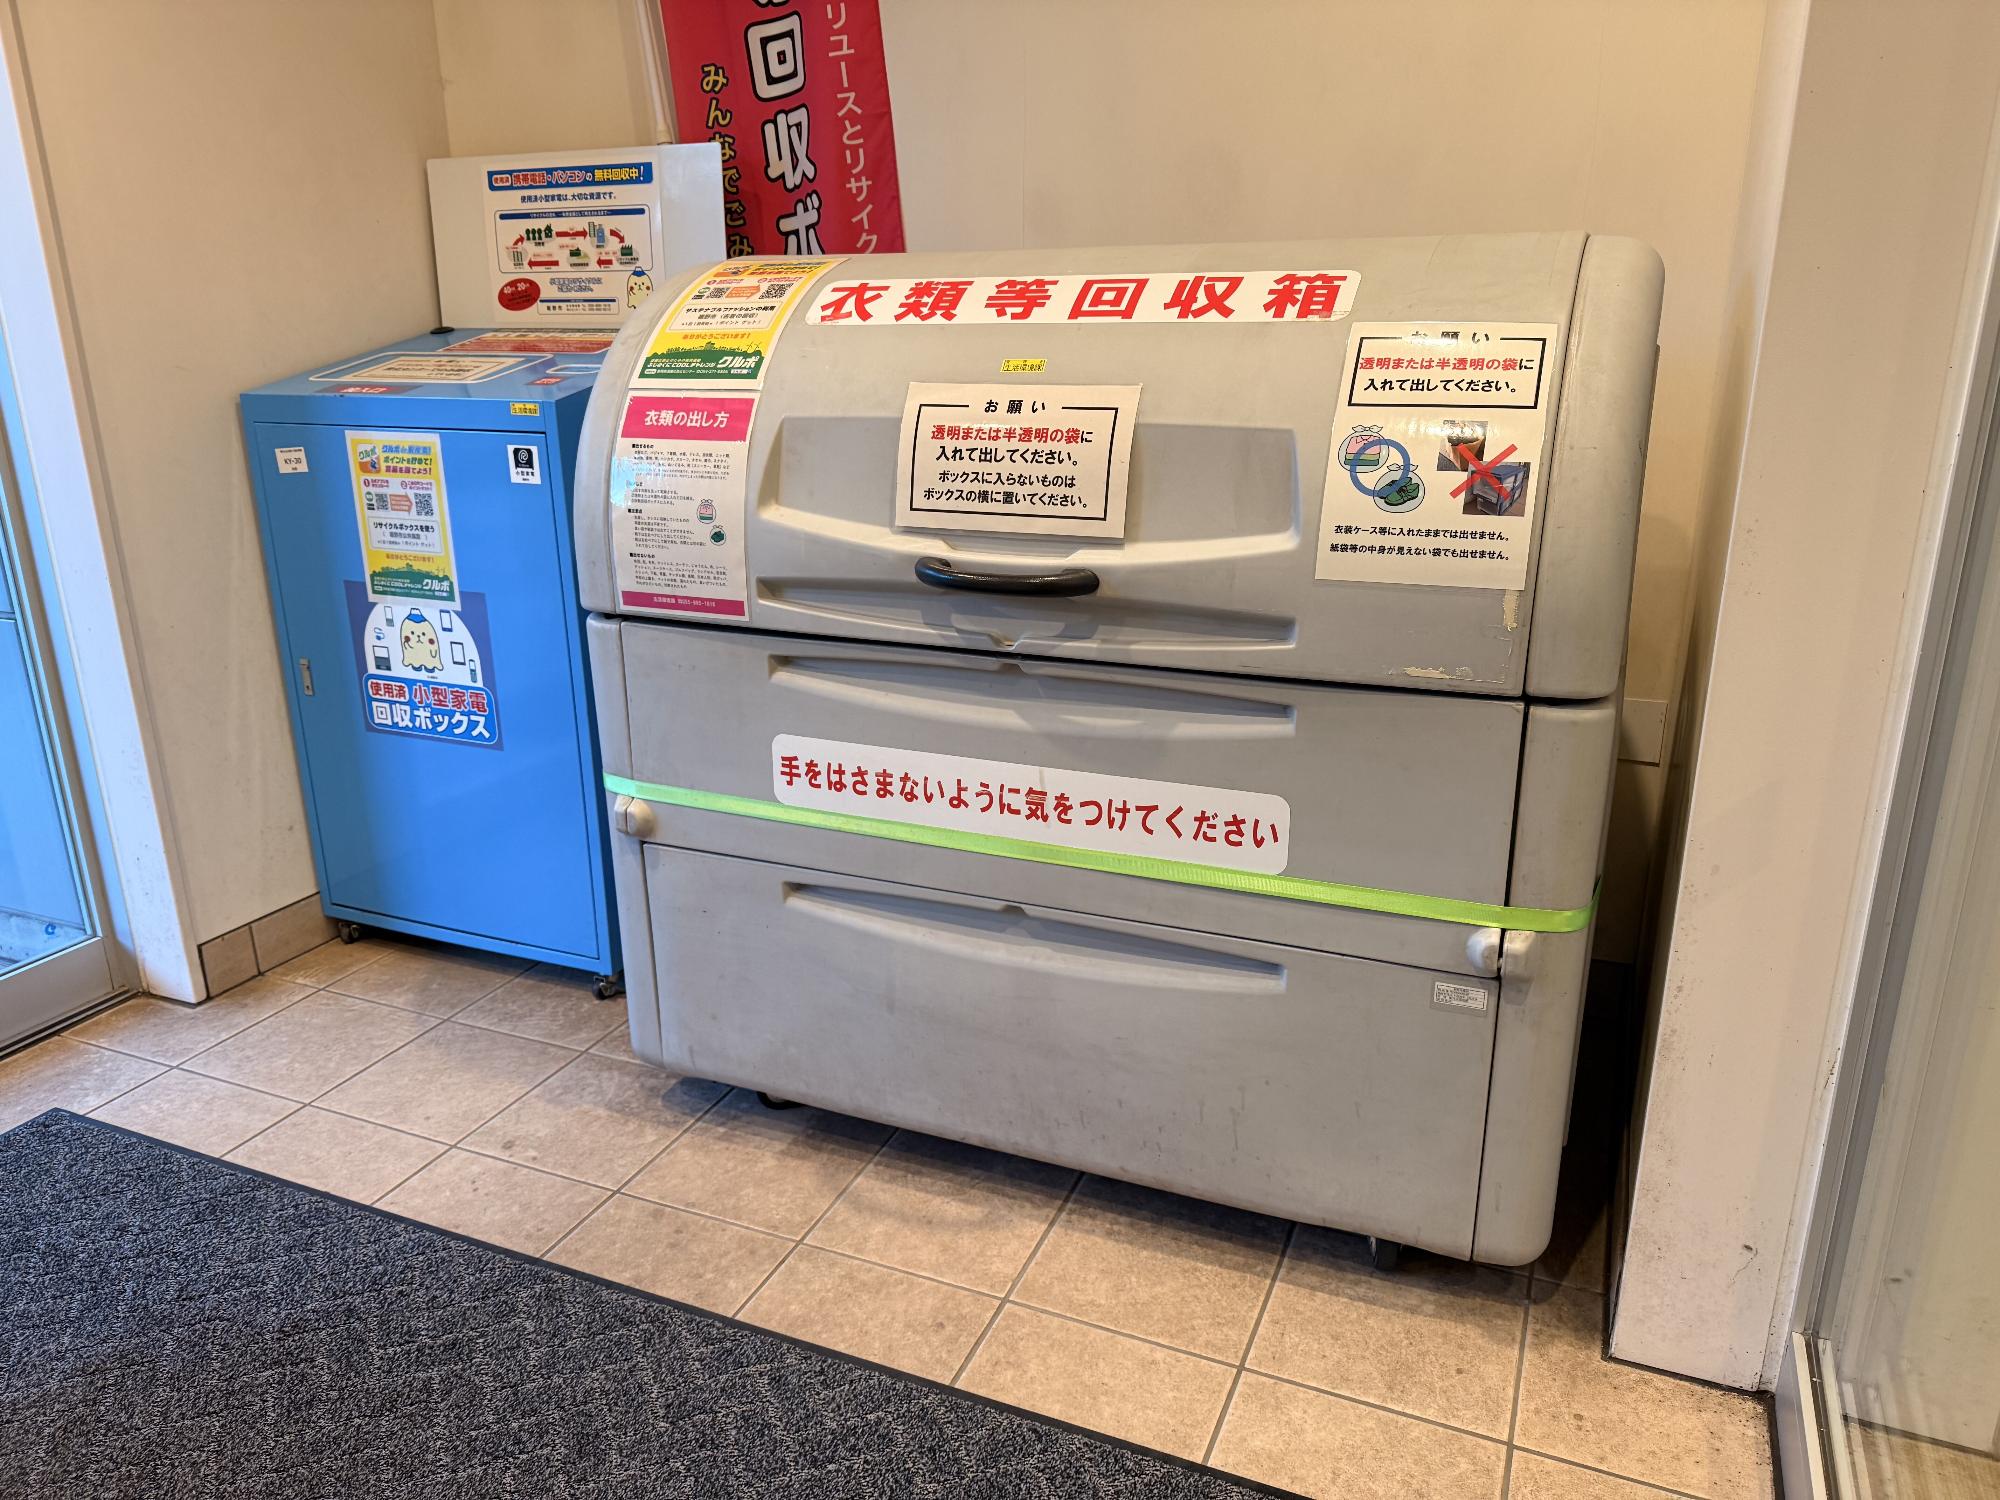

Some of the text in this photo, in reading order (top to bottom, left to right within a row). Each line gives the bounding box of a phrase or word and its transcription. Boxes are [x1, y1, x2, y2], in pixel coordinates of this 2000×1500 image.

[744, 0, 825, 255] 回収ボ
[820, 273, 1347, 323] 衣類等回収箱
[717, 355, 760, 369] クルポ
[1359, 357, 1534, 372] 透明または半透明の袋に
[1364, 378, 1517, 393] 入れて出してください。
[984, 399, 1046, 415] お願い
[644, 410, 729, 428] 衣類の出し方
[930, 424, 1094, 445] 透明または半透明の袋に
[936, 446, 1078, 466] 入れて出してください。
[938, 470, 1076, 488] ボックスに入らないものは
[923, 488, 1088, 508] ボックスの横に置いてください。
[1334, 524, 1509, 542] 衣装ケース等に入れたままでは出せません。
[1330, 543, 1510, 561] 紙袋等の中身が見えない袋でも出せません。
[369, 681, 488, 714] 使用済 小型家電
[371, 701, 491, 739] 回収ボックス
[780, 755, 1280, 850] 手をはさまないように気をつけてください
